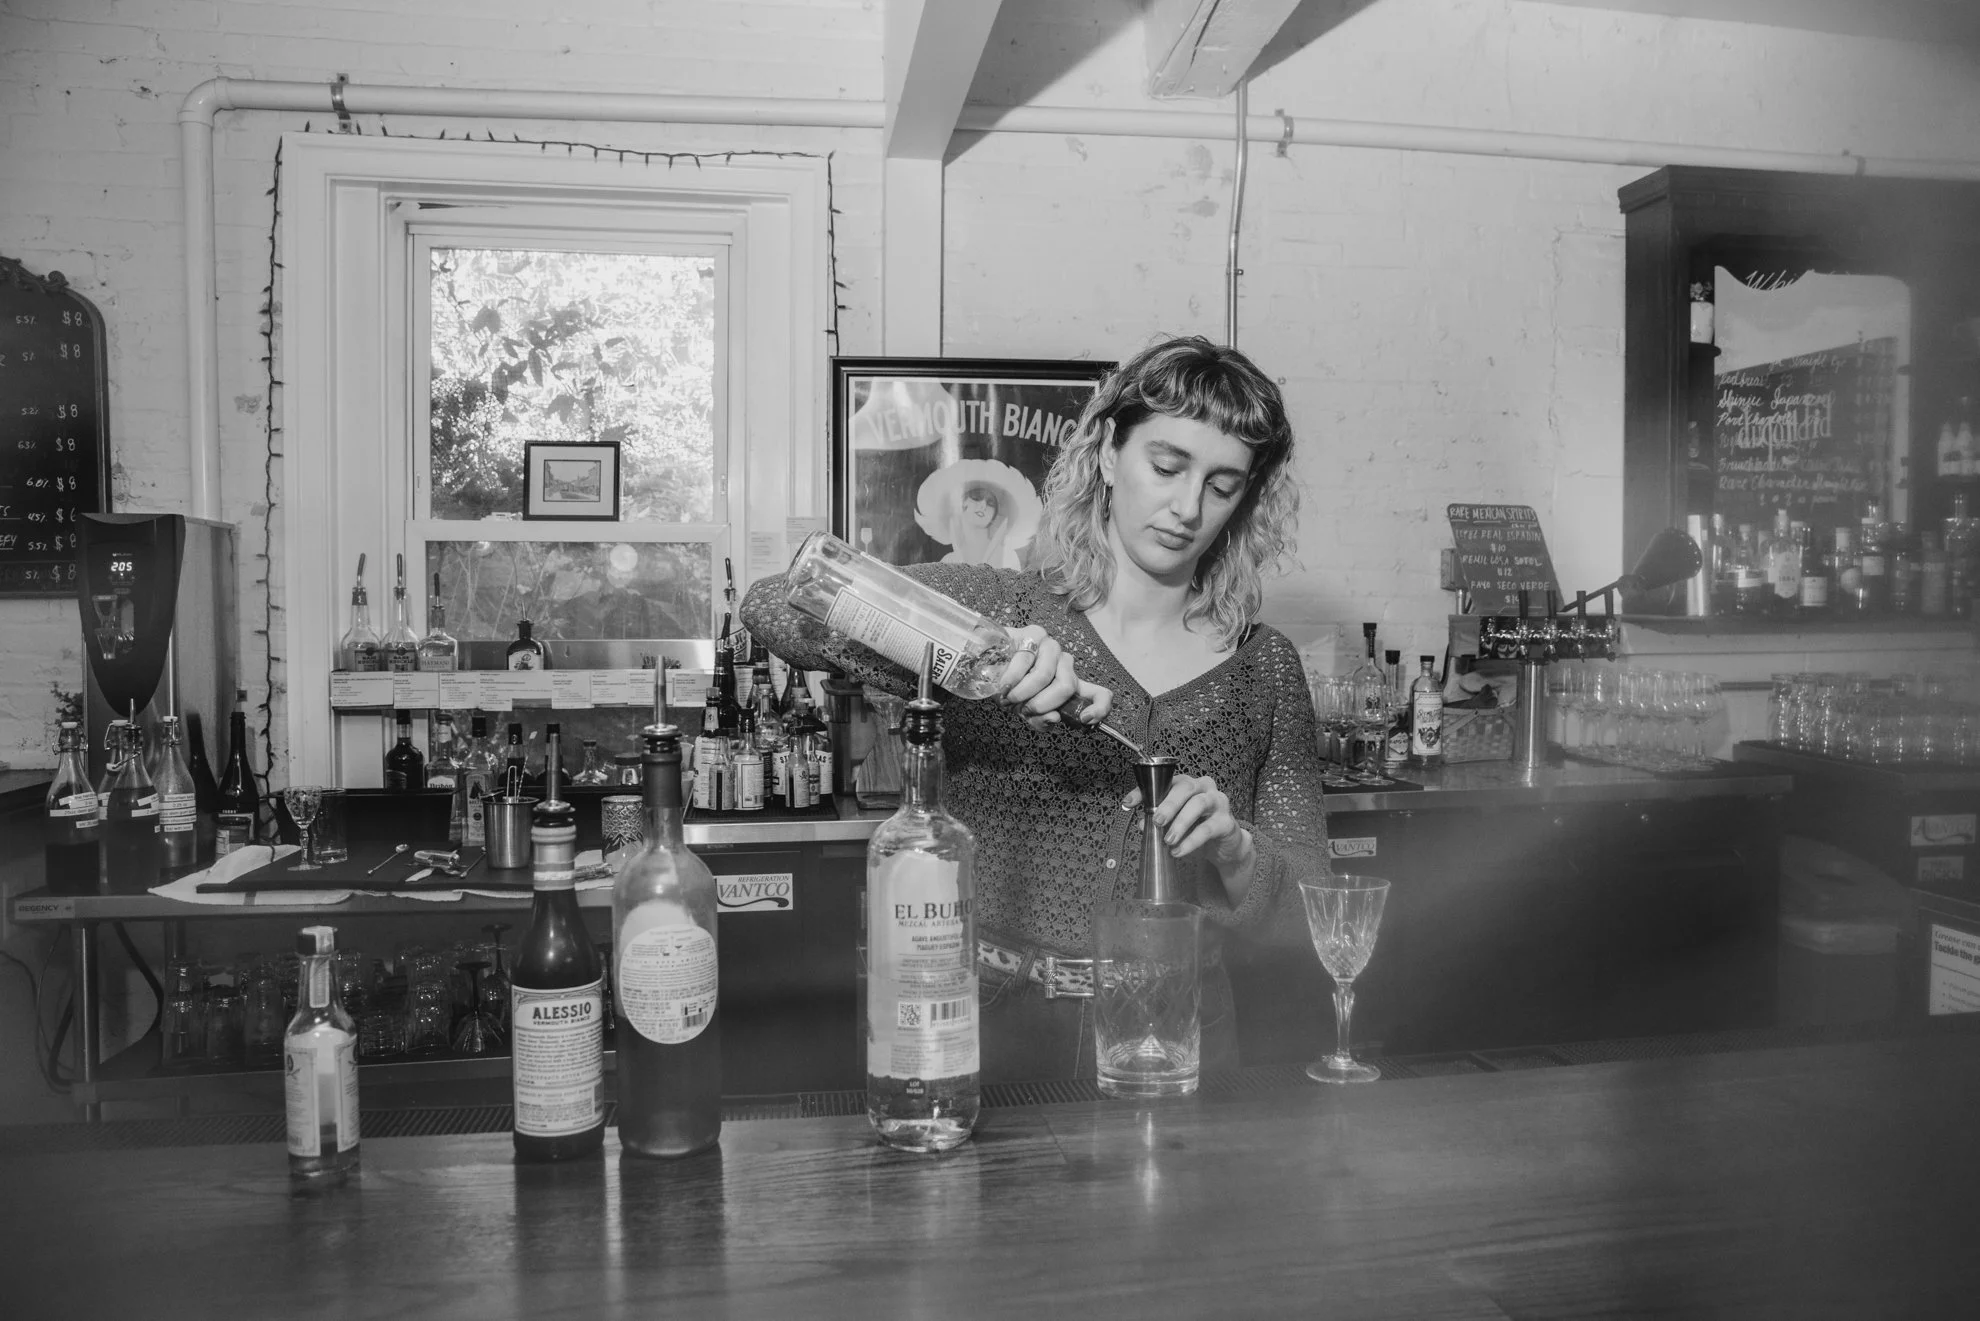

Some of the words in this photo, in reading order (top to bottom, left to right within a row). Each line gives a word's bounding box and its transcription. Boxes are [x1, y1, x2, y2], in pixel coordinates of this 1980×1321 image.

[866, 399, 994, 445] VERMOUTH
[1003, 403, 1080, 447] BIANC
[110, 561, 133, 572] 205
[737, 874, 790, 883] REFRIGERATION
[717, 881, 791, 899] VANTCO
[894, 903, 919, 920] EL
[923, 898, 974, 920] BUHO
[532, 1001, 592, 1020] ALESSIO
